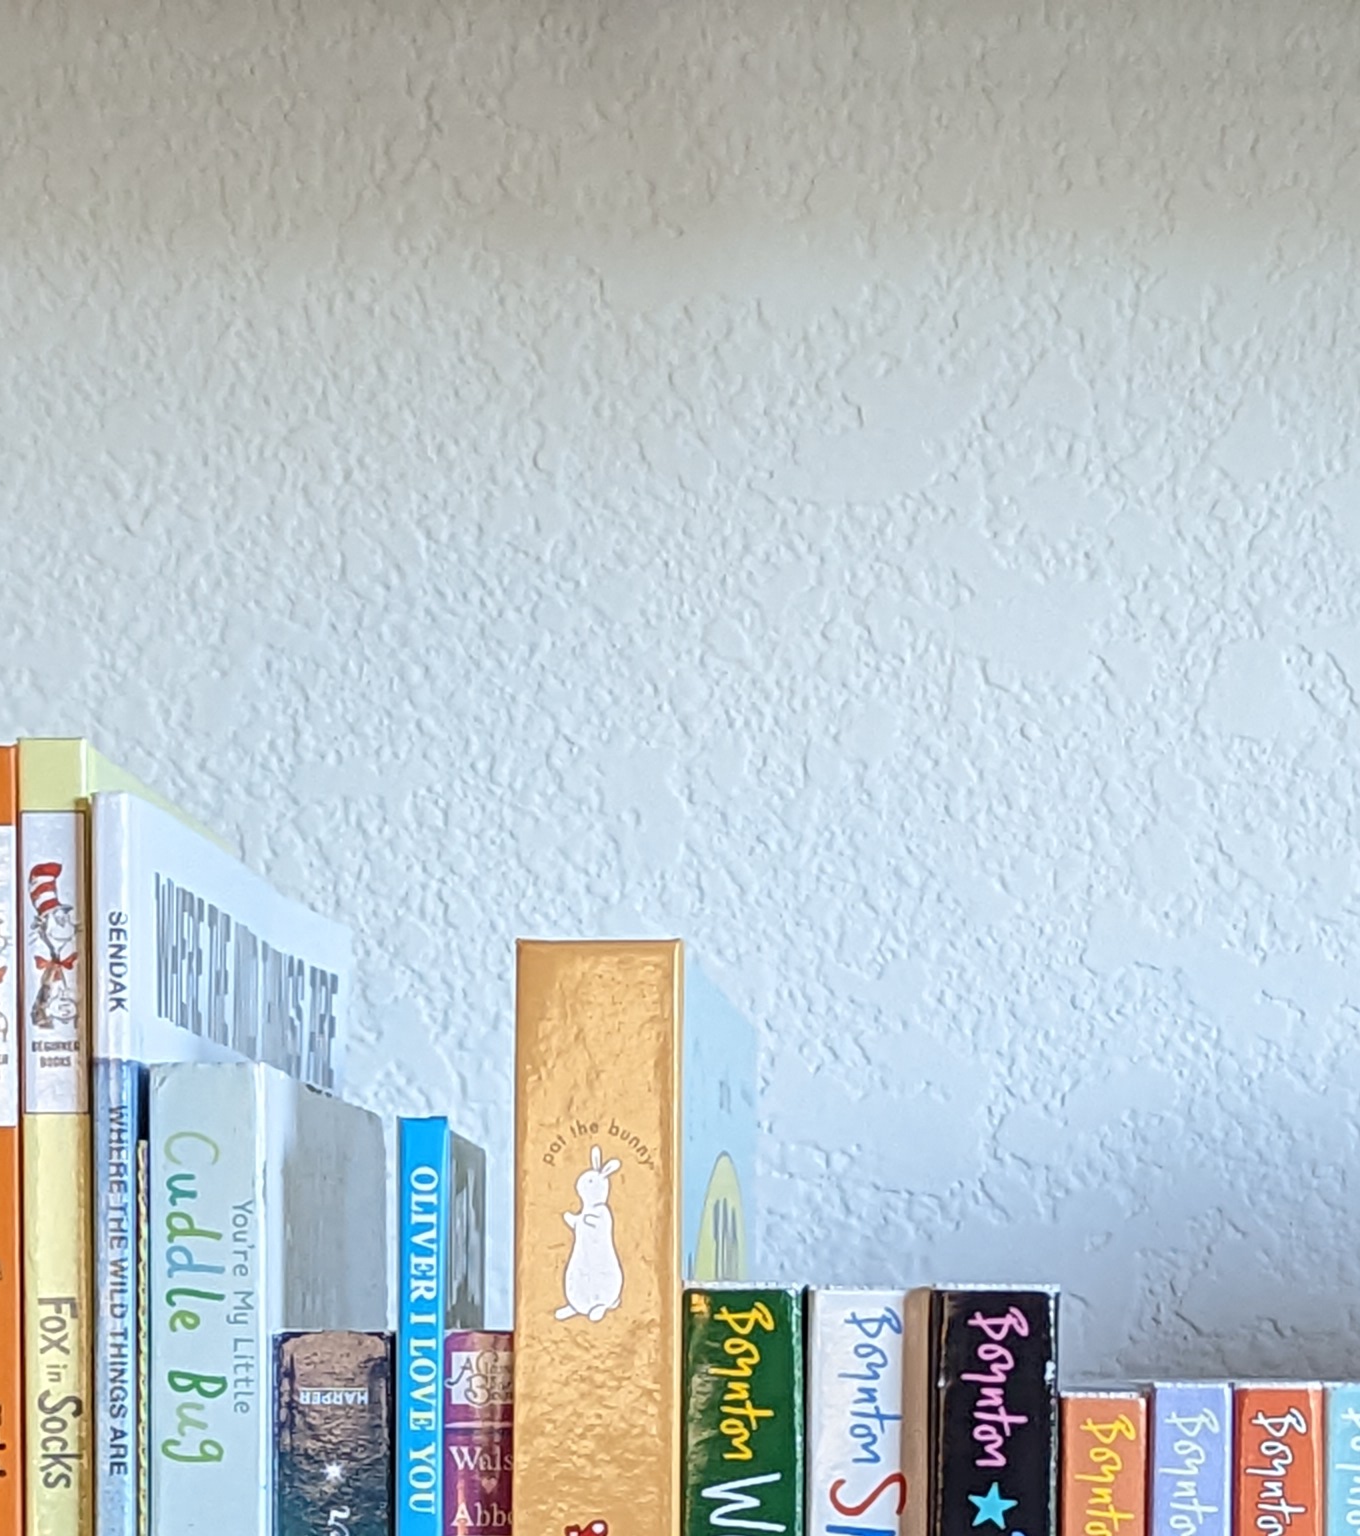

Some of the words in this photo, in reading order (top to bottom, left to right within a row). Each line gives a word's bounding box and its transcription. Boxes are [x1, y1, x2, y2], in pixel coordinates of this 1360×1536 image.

[108, 911, 128, 1013] SENDAK
[109, 1106, 128, 1193] WHERE
[542, 1134, 567, 1167] pat
[570, 1119, 599, 1139] the
[608, 1118, 655, 1171] bunny
[109, 1203, 128, 1250] THE
[163, 1131, 226, 1333] Cuddle
[231, 1200, 254, 1278] You're
[410, 1165, 440, 1302] OLIVER
[109, 1258, 128, 1319] WILD
[227, 1291, 255, 1326] My
[411, 1311, 437, 1325] I
[45, 1362, 68, 1383] in
[109, 1327, 128, 1420] THINGS
[233, 1337, 255, 1414] Little
[300, 1391, 368, 1405] HARPER
[410, 1332, 437, 1432] LOVE
[709, 1302, 774, 1460] Boynton
[839, 1307, 902, 1465] Boynton
[961, 1306, 1029, 1467] Boynton
[37, 1388, 83, 1489] Socks
[109, 1427, 128, 1477] ARE
[161, 1370, 227, 1463] Bug
[409, 1438, 437, 1515] YOU
